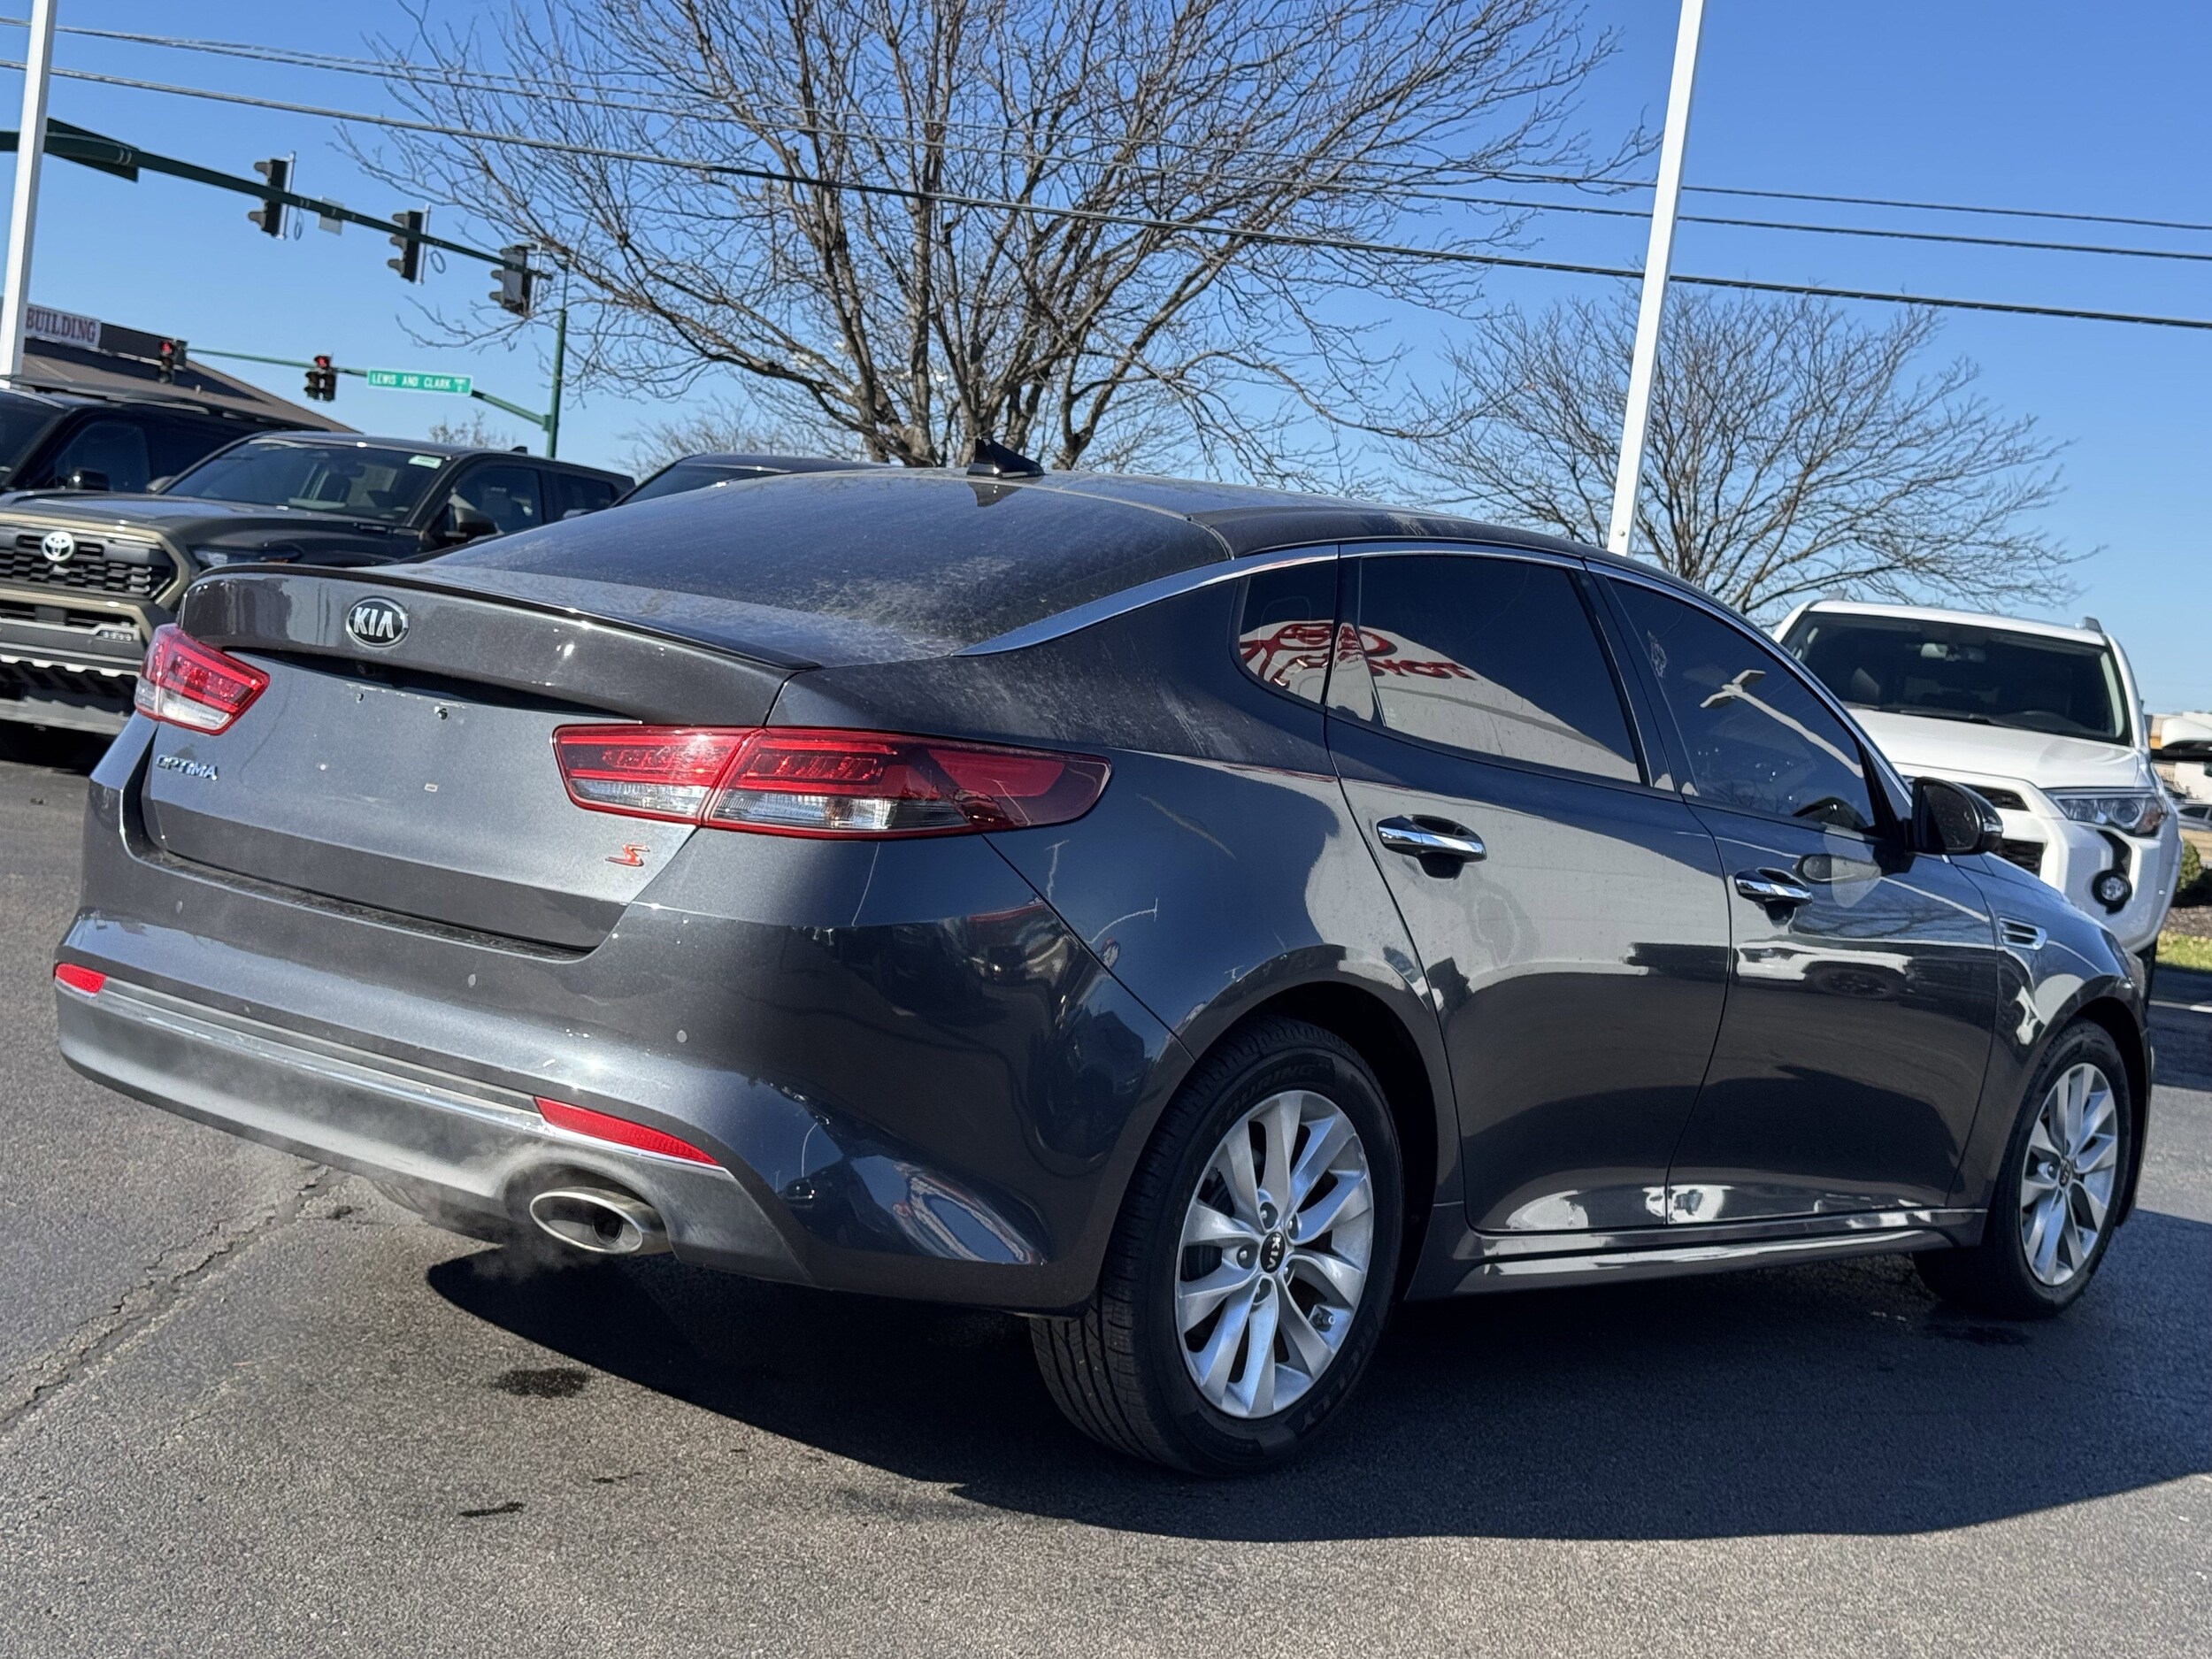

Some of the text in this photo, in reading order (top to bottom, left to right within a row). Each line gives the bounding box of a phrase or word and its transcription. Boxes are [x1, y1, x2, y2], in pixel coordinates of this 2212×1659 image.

[26, 306, 96, 342] BUILDING
[372, 373, 397, 386] LEWIS
[402, 375, 419, 388] AND
[424, 376, 451, 389] CLARK
[354, 607, 395, 639] KIA
[156, 755, 218, 780] OPTIMA
[604, 842, 650, 867] S
[1266, 1233, 1282, 1270] KIA
